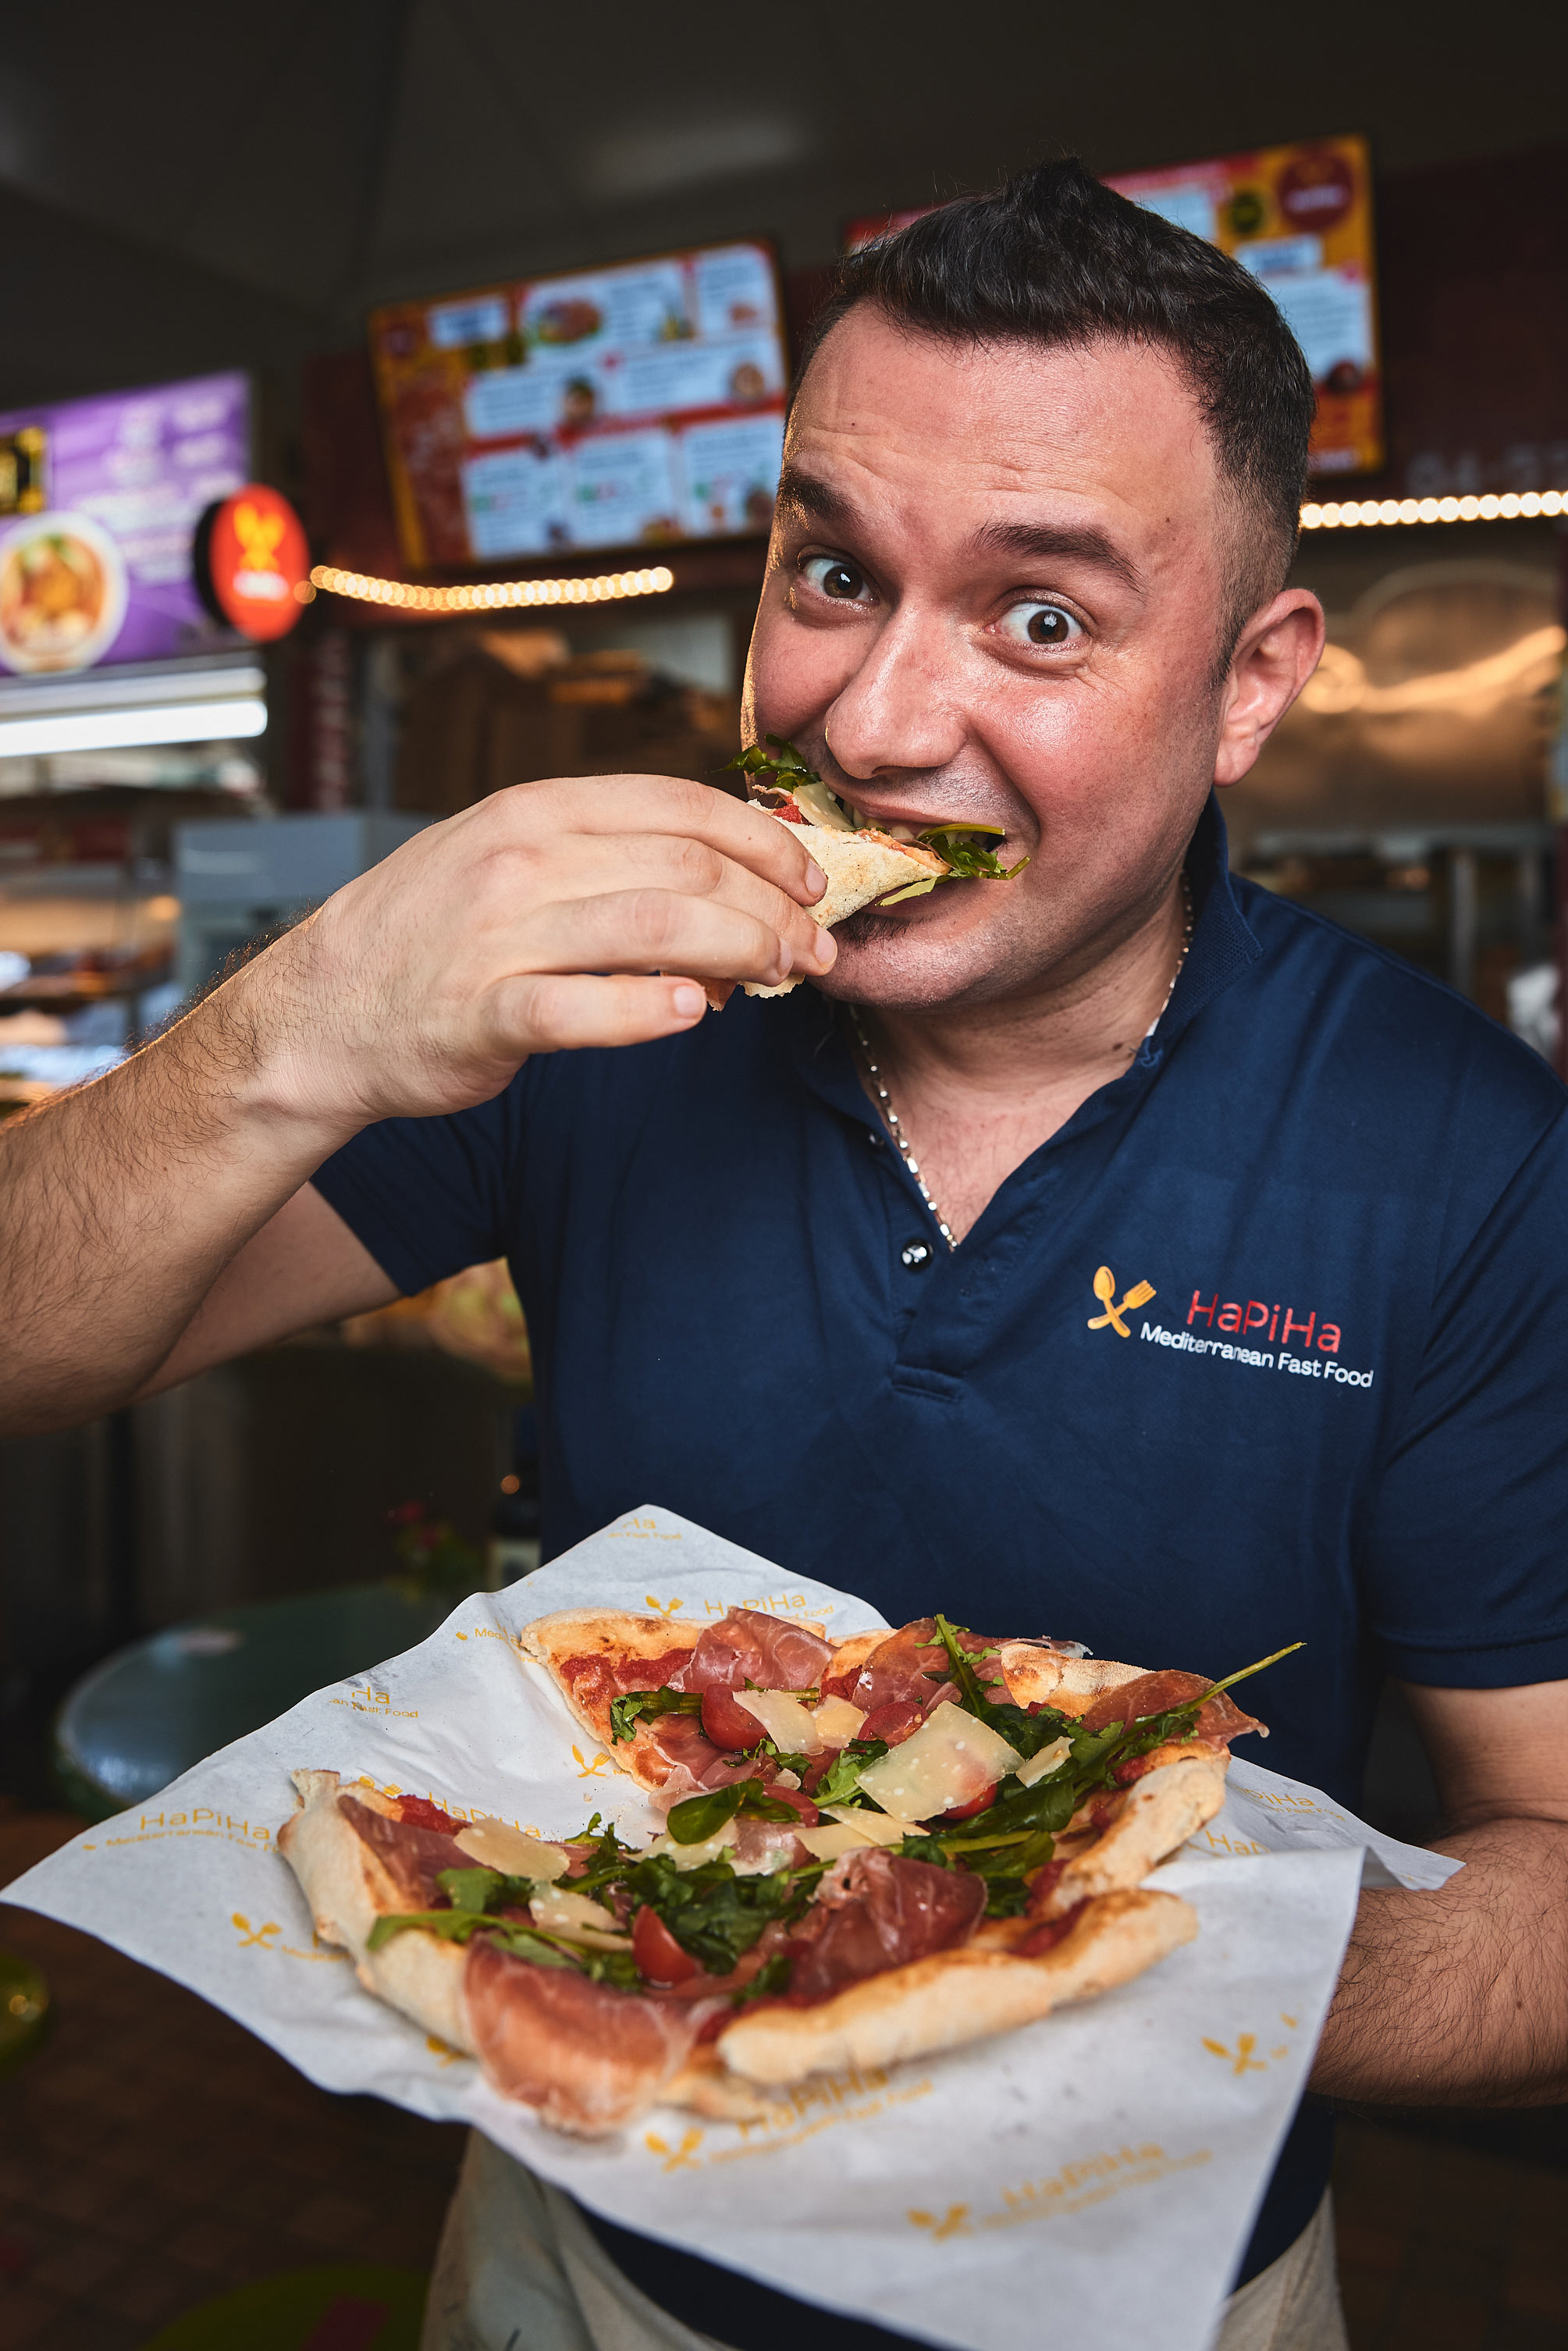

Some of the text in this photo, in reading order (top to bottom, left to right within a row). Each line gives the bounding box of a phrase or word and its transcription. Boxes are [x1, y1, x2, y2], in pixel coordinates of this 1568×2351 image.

[1186, 1290, 1342, 1353] HaPiHa
[1140, 1321, 1374, 1388] Mediterranean Fast Food
[704, 1593, 806, 1617] HPiHa
[386, 1708, 418, 1718] Food
[140, 1808, 270, 1841] HaPiHa
